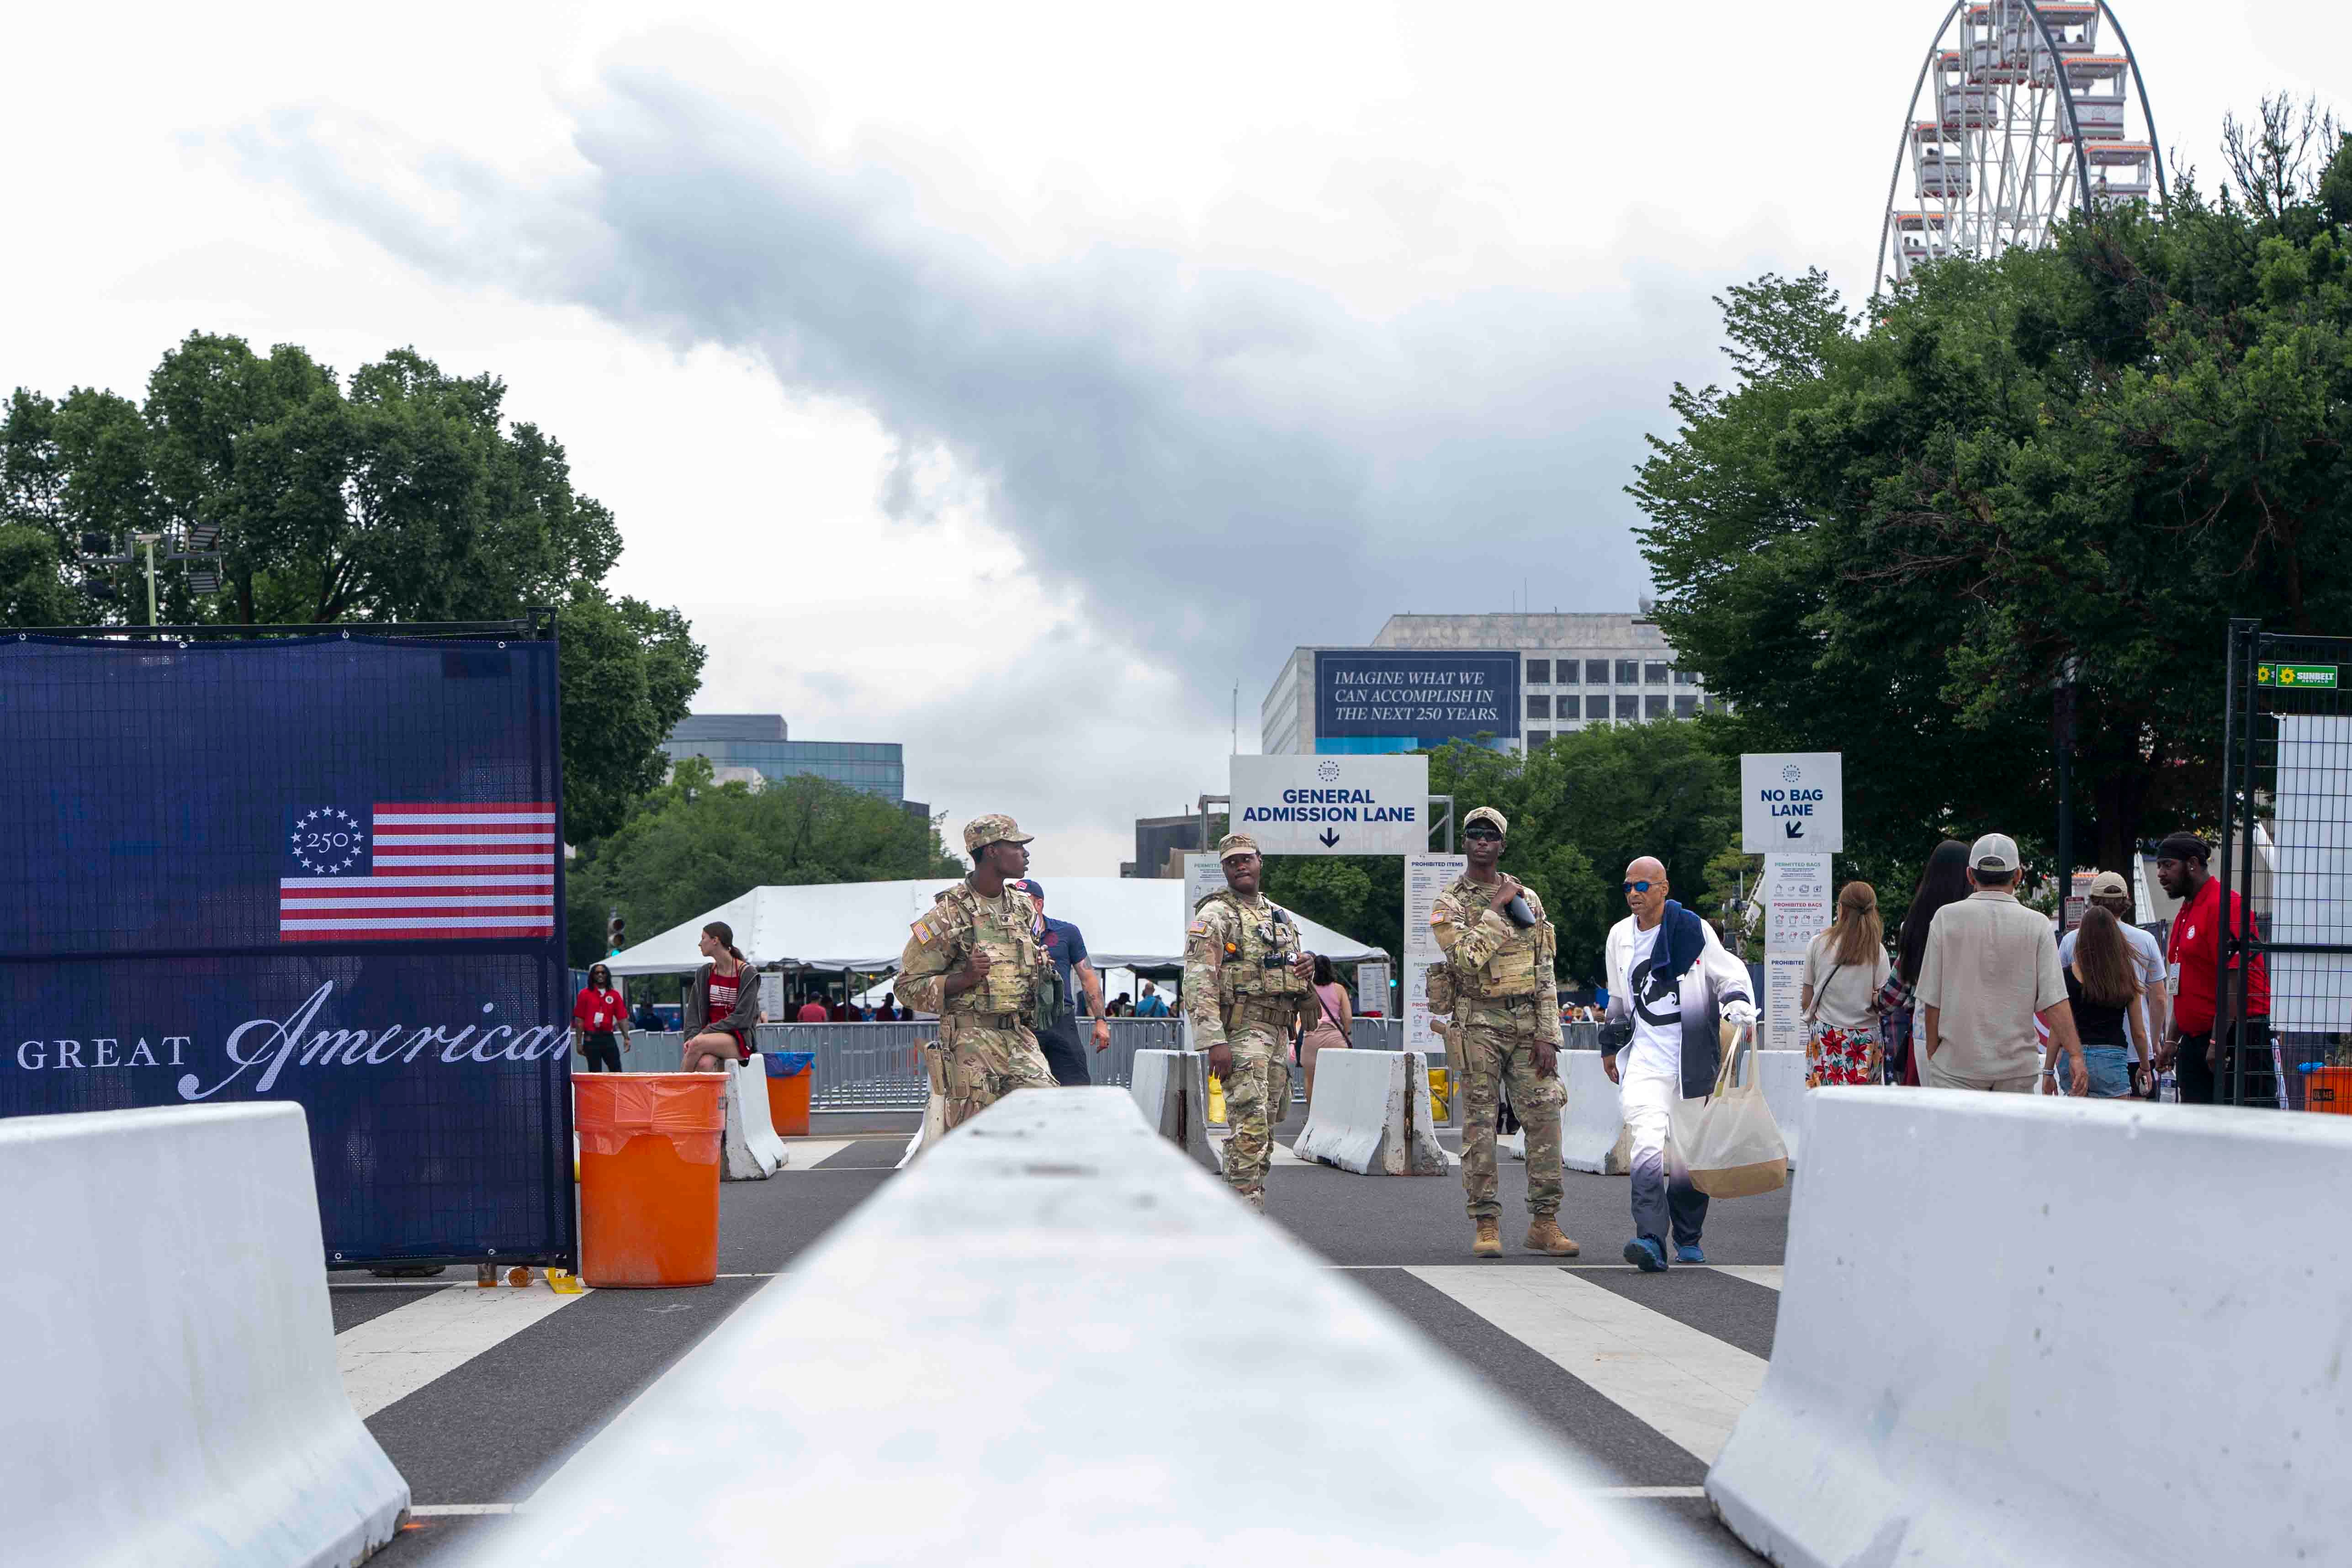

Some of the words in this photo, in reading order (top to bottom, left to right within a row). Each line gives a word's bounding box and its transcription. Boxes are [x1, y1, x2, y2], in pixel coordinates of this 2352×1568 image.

[1335, 672, 1404, 684] IMAGINE
[1409, 672, 1456, 685] WHAT
[1460, 672, 1484, 684] WE
[2297, 672, 2334, 680] SUNBELT
[1335, 689, 1367, 702] CAN
[1370, 690, 1472, 702] ACCOMPLISH
[1476, 690, 1494, 702] IN
[1335, 707, 1368, 720] THE
[1370, 707, 1414, 720] NEXT
[1415, 707, 1442, 720] 250
[1446, 708, 1499, 720] YEARS.
[1283, 789, 1375, 804] GENERAL
[1761, 789, 1785, 802] NO
[1790, 789, 1823, 801] BAG
[1243, 807, 1357, 822] ADMISSION
[1364, 807, 1415, 822] LANE
[1771, 804, 1813, 816] LANE
[307, 832, 349, 853] 250
[17, 1036, 191, 1070] GREAT
